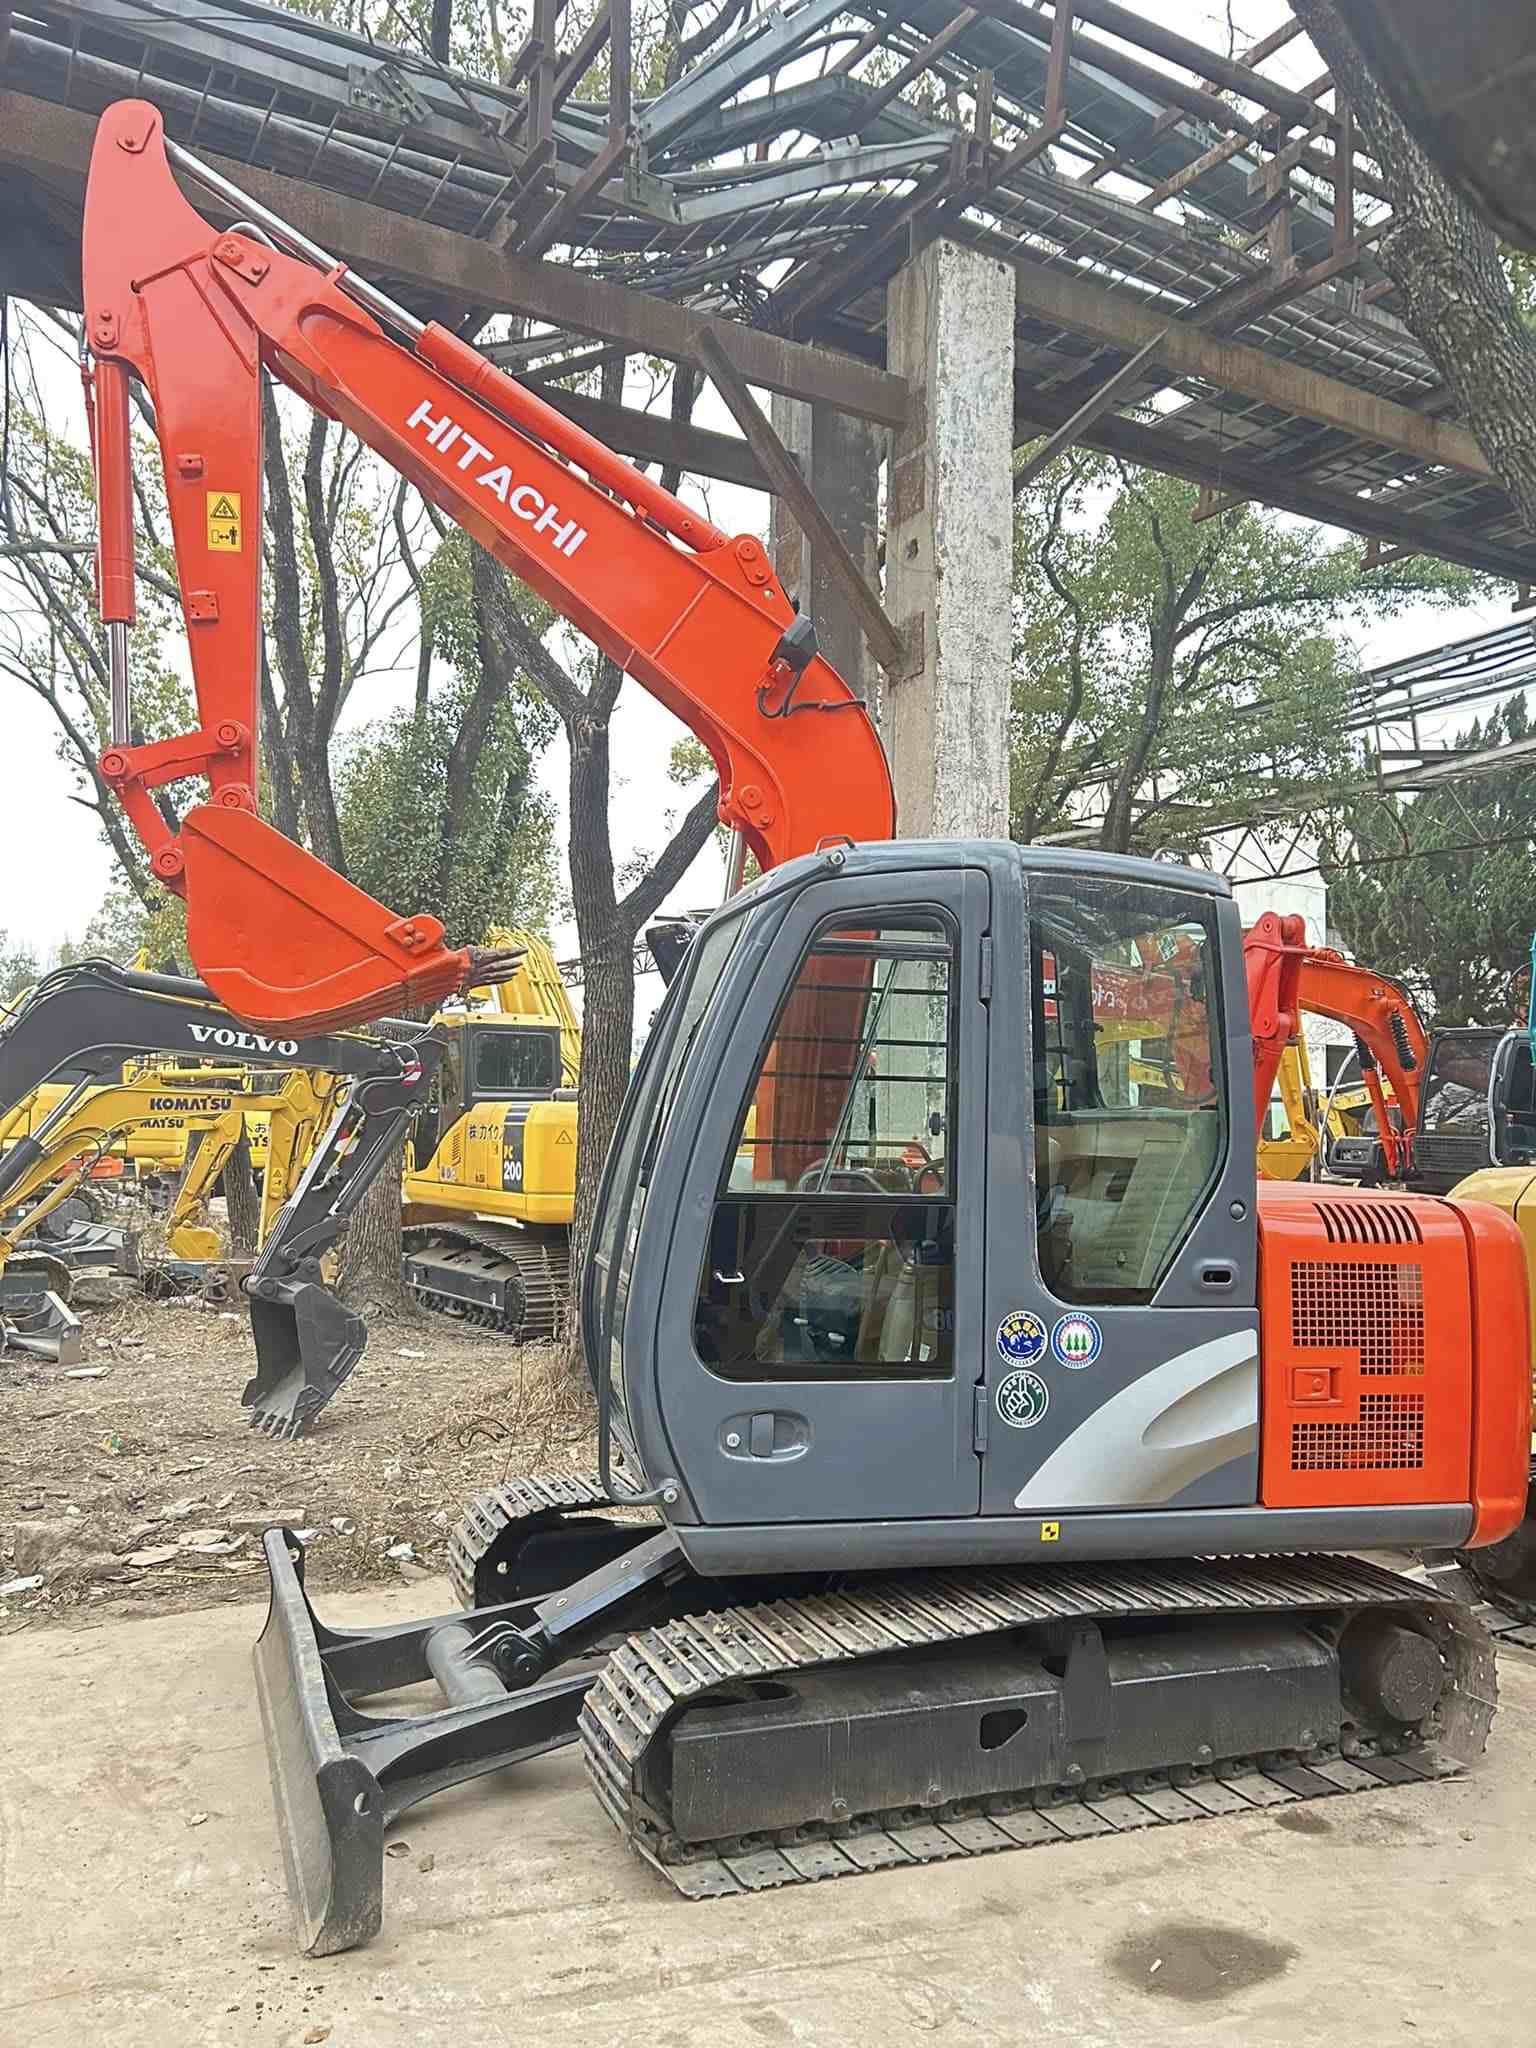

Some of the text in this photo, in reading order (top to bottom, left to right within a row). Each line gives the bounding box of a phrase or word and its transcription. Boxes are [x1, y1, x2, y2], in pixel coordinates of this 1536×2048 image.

[406, 400, 587, 557] HITACHI
[187, 1024, 298, 1056] VOLVO
[149, 1096, 231, 1110] KOMATSU
[140, 1117, 184, 1128] MATSU
[503, 1161, 522, 1180] 200
